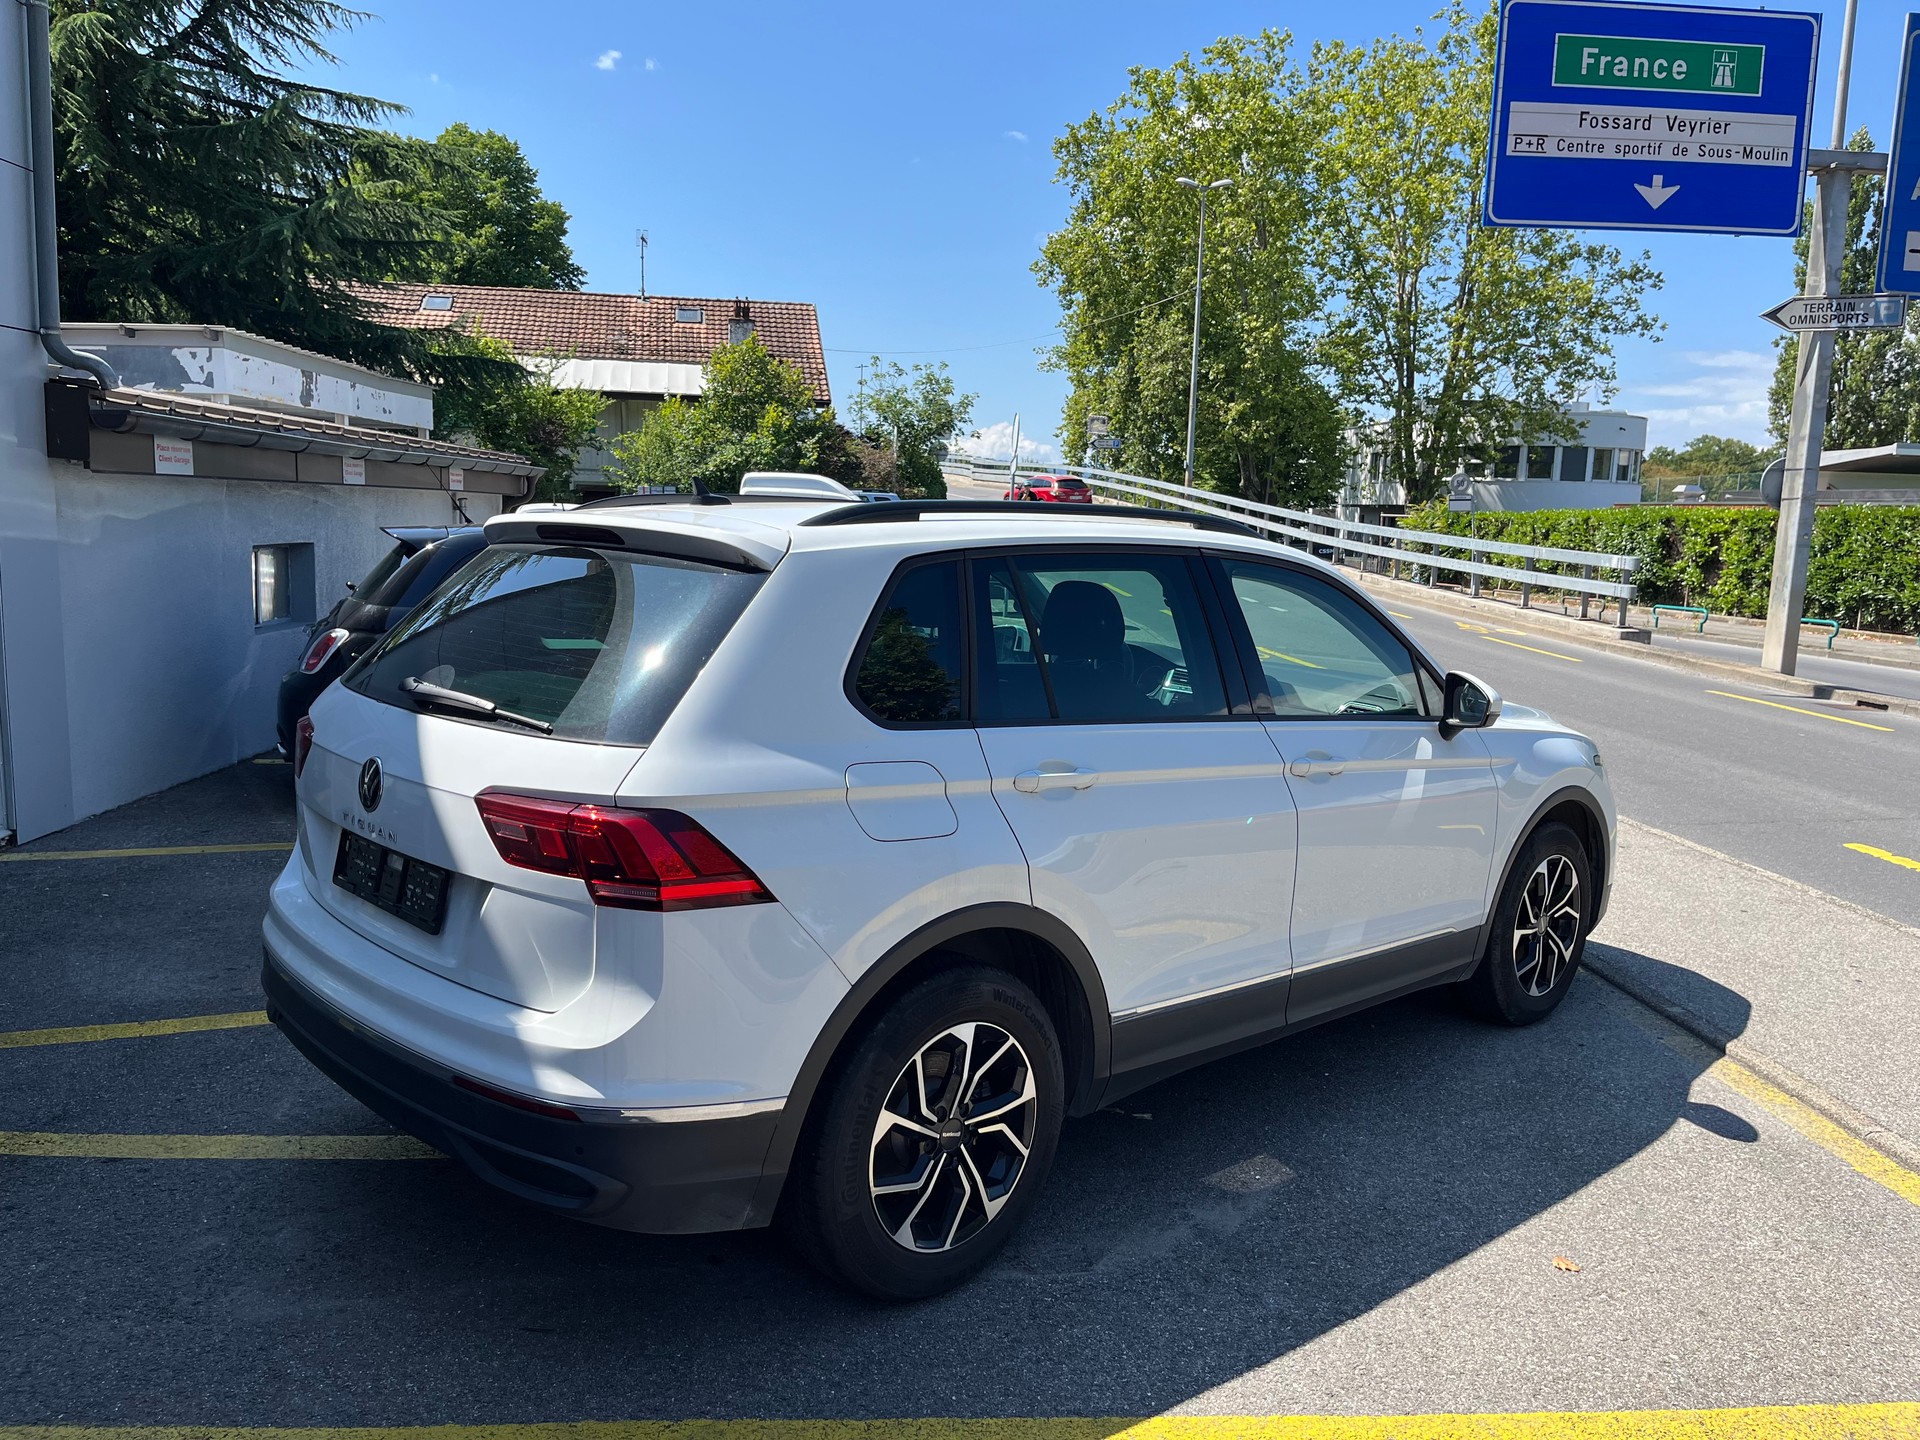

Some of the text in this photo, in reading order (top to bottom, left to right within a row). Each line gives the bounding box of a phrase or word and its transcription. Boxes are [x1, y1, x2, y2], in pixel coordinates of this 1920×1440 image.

[1581, 48, 1688, 80] France
[1579, 111, 1731, 137] Fossard Veyrier
[1512, 136, 1788, 161] P+R Centre sportif de Sous-Moulin
[1789, 313, 1869, 325] OMNISPORTS
[1803, 302, 1856, 313] TERRAIN
[343, 812, 398, 844] TIGUAN
